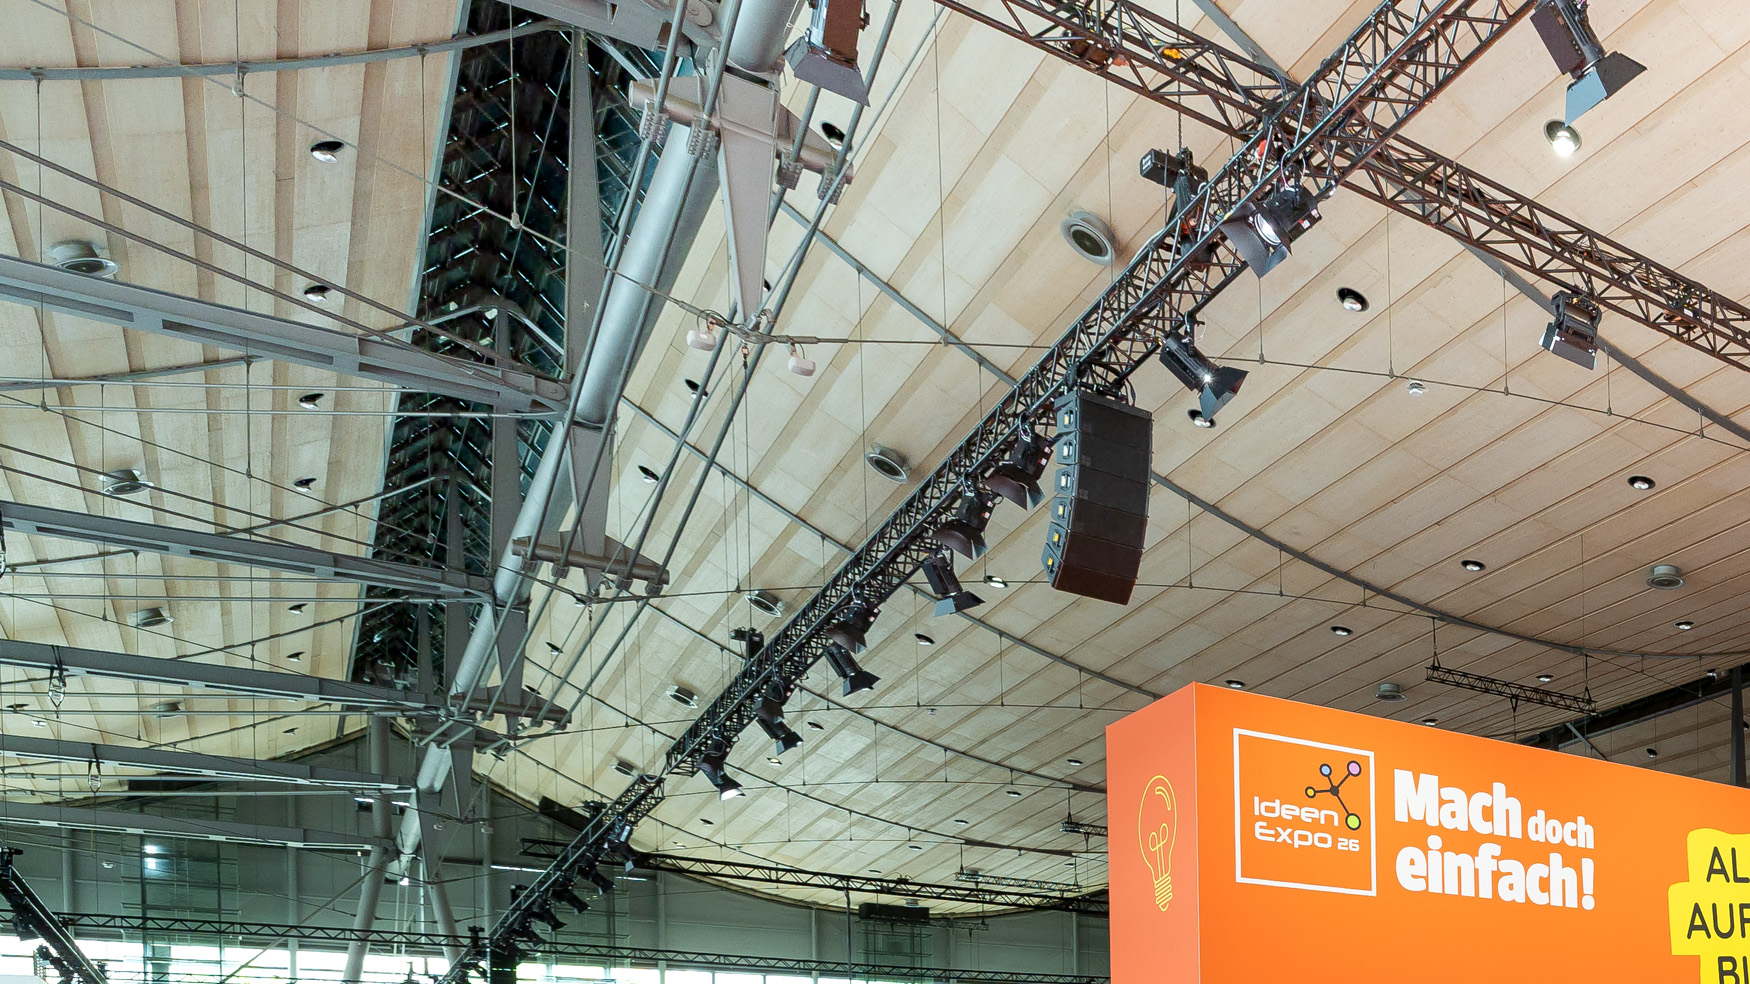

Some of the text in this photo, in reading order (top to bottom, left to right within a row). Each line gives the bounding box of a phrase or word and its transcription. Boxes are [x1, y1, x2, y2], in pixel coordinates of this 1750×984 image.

[1253, 796, 1339, 827] Ideen
[1394, 768, 1595, 849] Mach doch
[1254, 821, 1360, 852] Expo 26
[1395, 834, 1596, 911] einfach!
